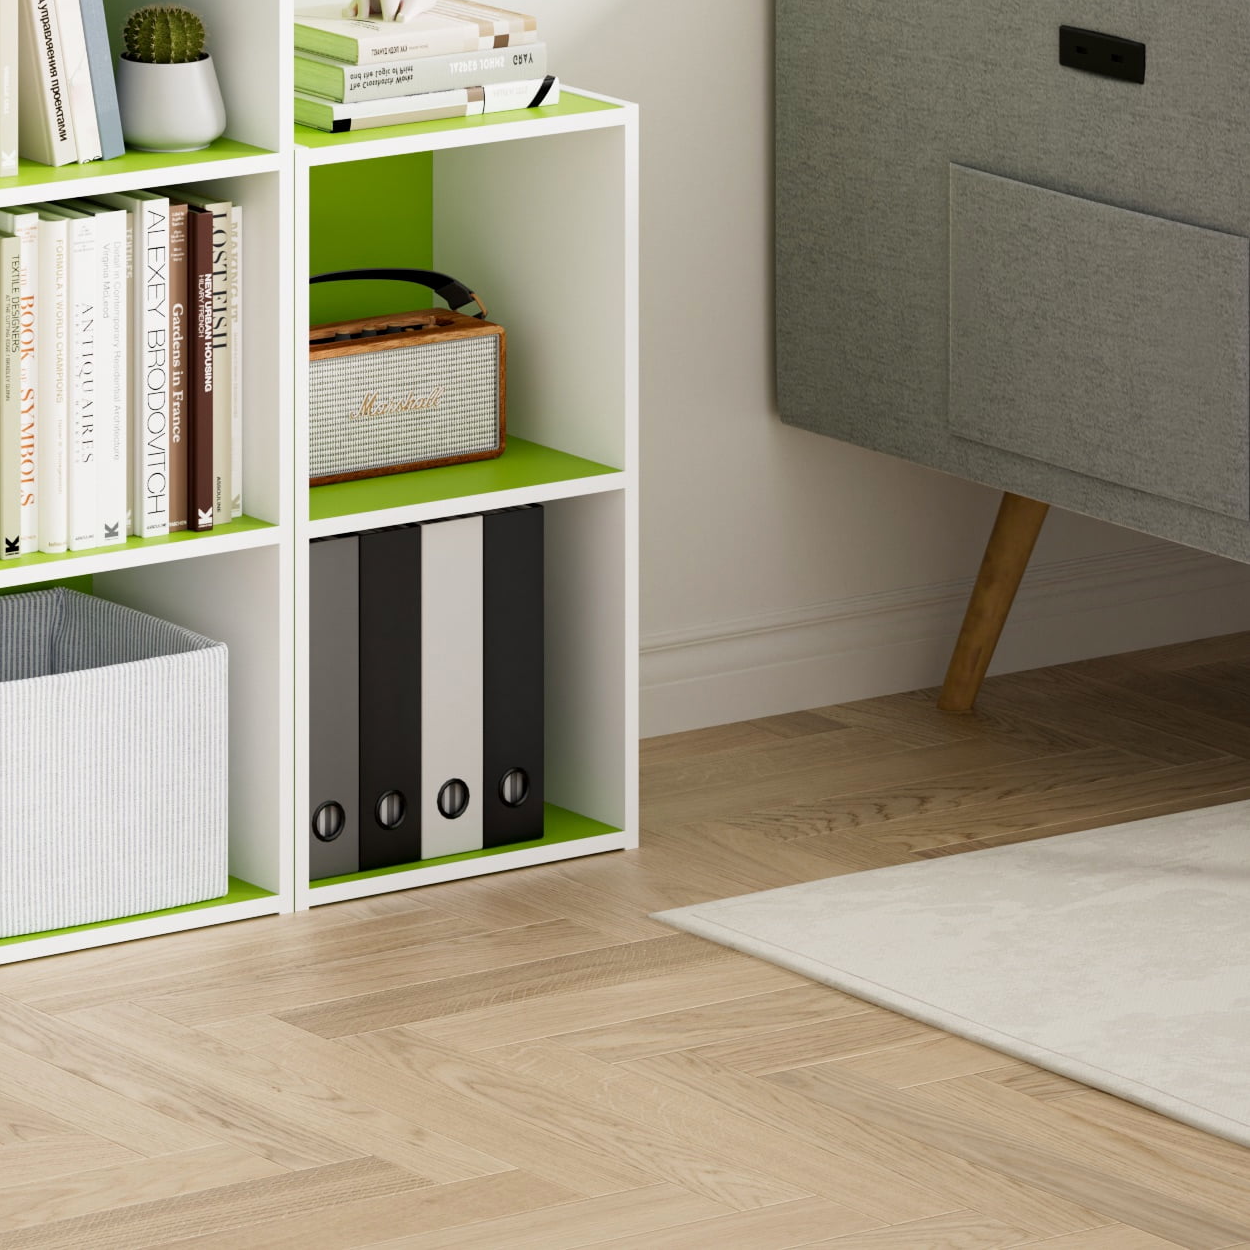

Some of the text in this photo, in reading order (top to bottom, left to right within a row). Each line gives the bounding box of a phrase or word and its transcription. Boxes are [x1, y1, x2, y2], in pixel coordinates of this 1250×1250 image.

[49, 78, 68, 143] проектами
[101, 243, 111, 319] Virginia McLeod
[112, 241, 121, 268] Detail
[11, 254, 20, 353] TEXTILE DESIGNERS
[55, 300, 63, 338] WORLD
[112, 281, 121, 348] Contemporary
[197, 274, 206, 304] HILARY
[20, 294, 35, 361] BOOK
[204, 273, 213, 393] NEW URBAN HOUSING
[55, 341, 63, 404] CHAMPIONS
[77, 303, 94, 464] ANTIQUAIRES
[112, 350, 121, 402] Residential
[146, 209, 166, 516] ALEXEY BRODOVITCH
[172, 302, 185, 444] Gardens in France
[112, 404, 121, 461] Architecture
[349, 386, 445, 421] Marshall
